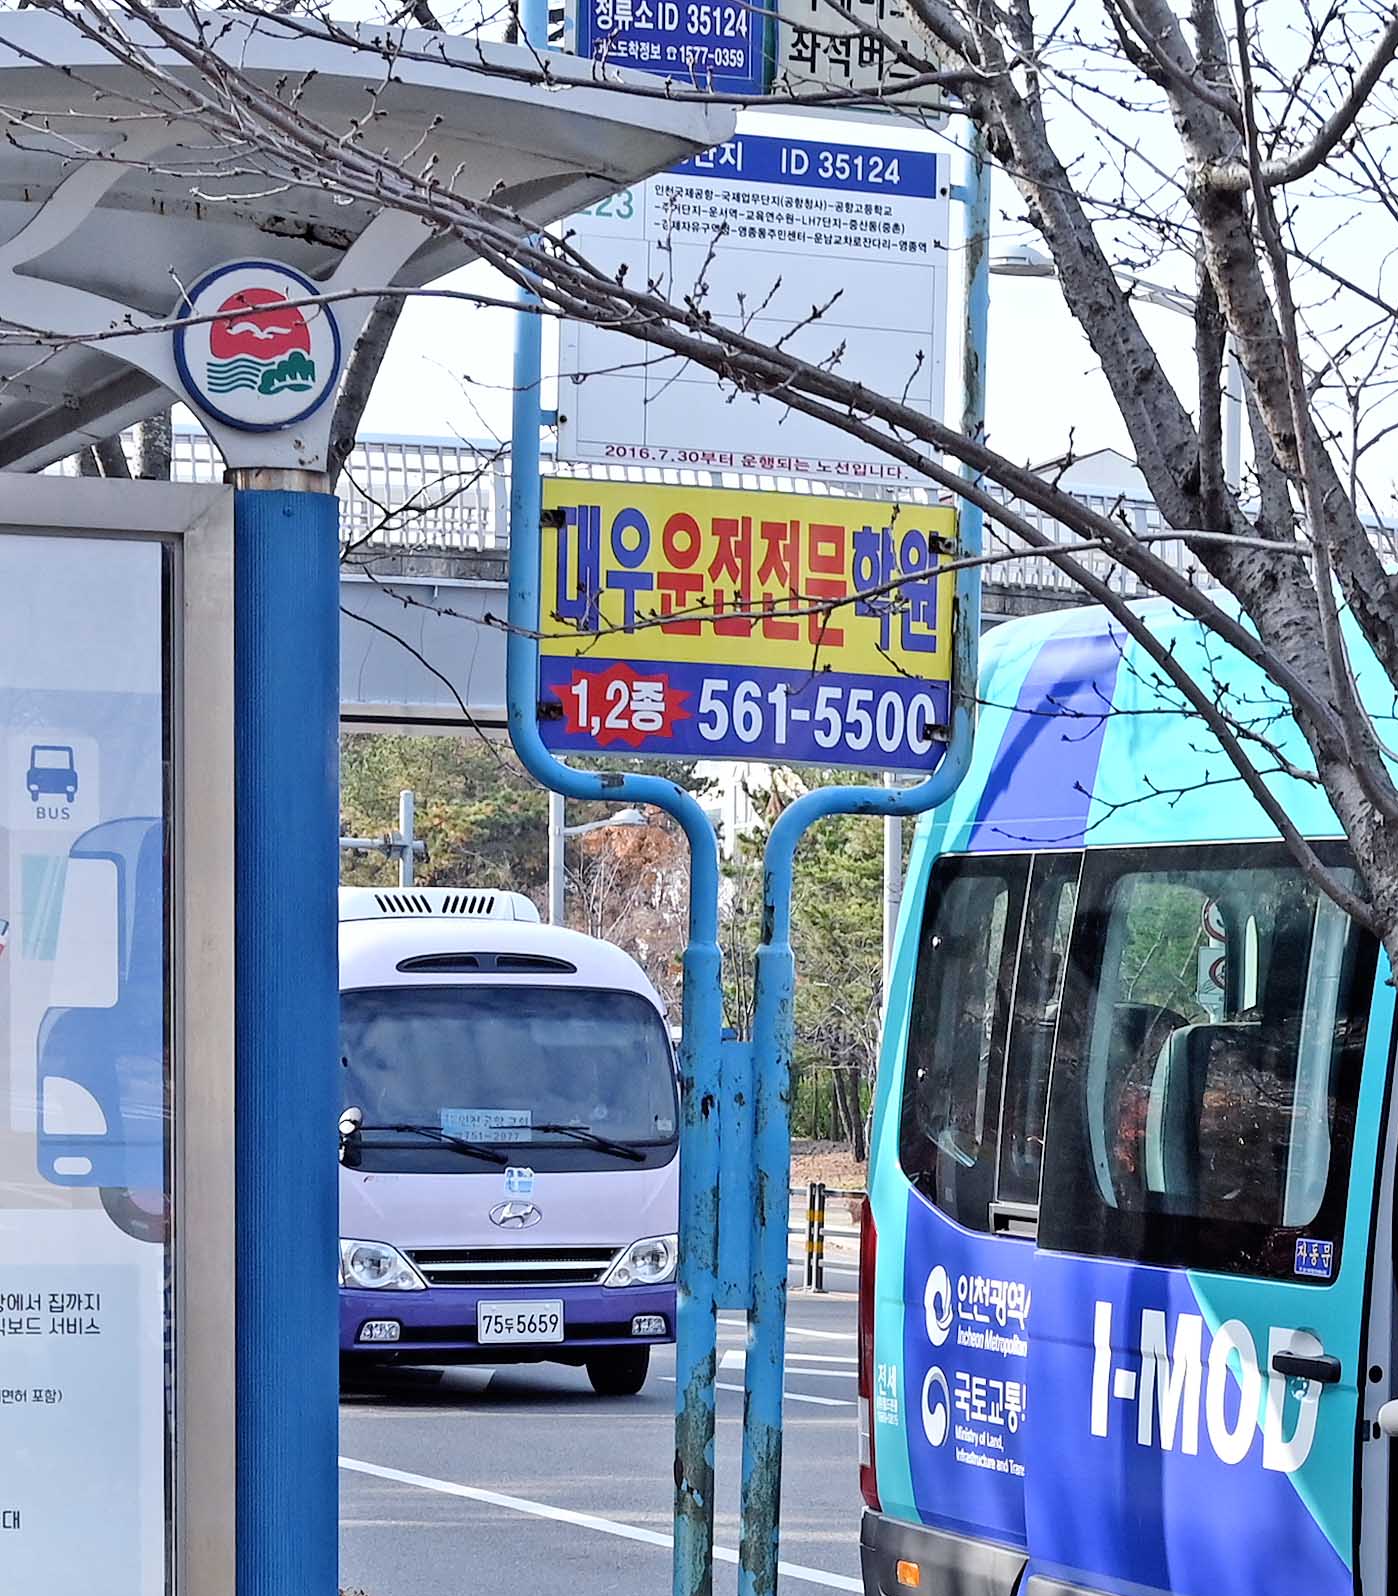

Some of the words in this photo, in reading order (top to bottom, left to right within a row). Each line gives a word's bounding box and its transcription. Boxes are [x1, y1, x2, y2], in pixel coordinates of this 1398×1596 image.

[687, 4, 748, 39] 35124
[681, 141, 743, 172] 단지
[781, 147, 810, 176] ID
[818, 151, 901, 185] 35124
[576, 189, 634, 220] 23
[605, 444, 733, 467] 2016.7.30부터
[741, 454, 810, 473] 운행되는
[816, 460, 909, 481] 노선입니다.
[556, 504, 937, 654] 대우운전전문학원
[571, 679, 665, 736] 1,2종
[698, 678, 936, 755] 561-5500
[36, 806, 70, 820] BUS
[1297, 1241, 1330, 1268] 자동문
[48, 1293, 100, 1313] 집까지
[48, 1317, 101, 1335] 서비스
[482, 1313, 559, 1334] 75두5659
[957, 1325, 984, 1350] Incheon
[32, 1388, 63, 1404] 포함)
[1090, 1300, 1323, 1473] I-MOD
[955, 1424, 979, 1447] Ministry
